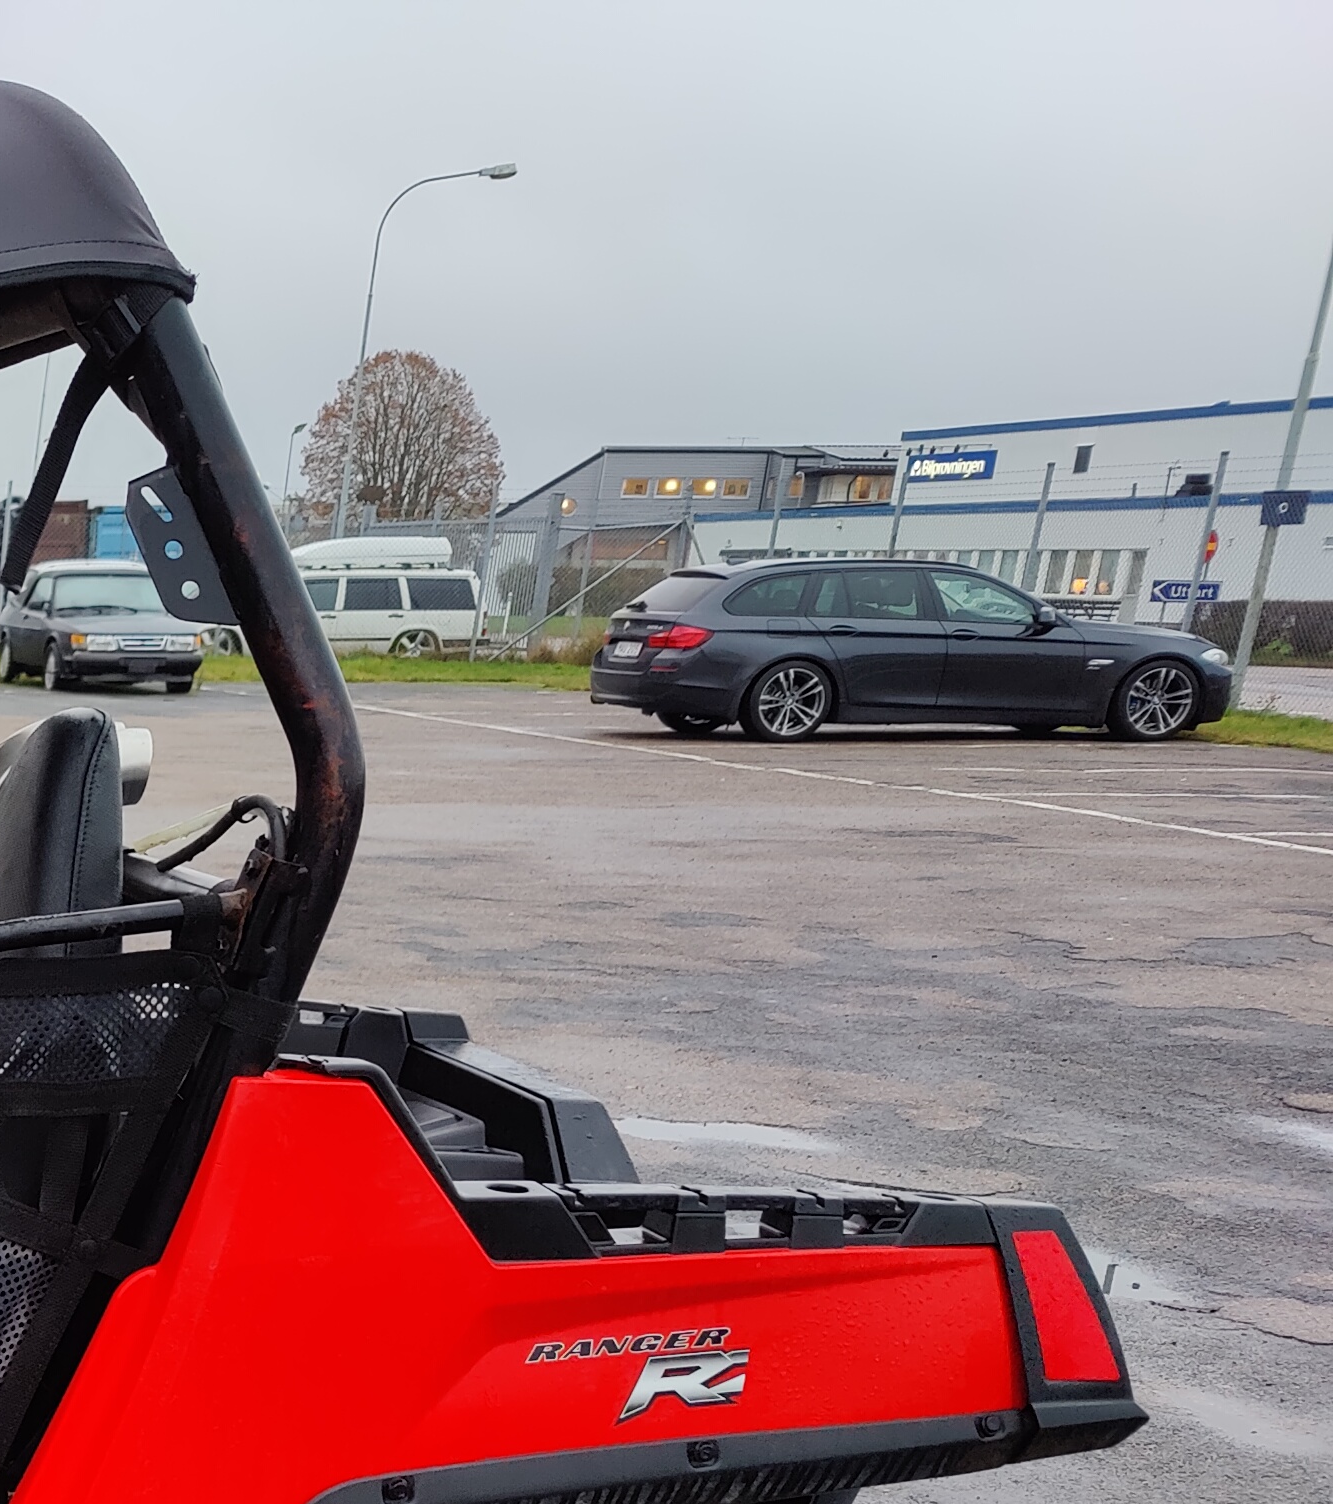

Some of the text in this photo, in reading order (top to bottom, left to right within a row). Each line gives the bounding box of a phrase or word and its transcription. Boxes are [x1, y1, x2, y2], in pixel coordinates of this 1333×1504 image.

[921, 457, 986, 479] Bilprovningen
[1171, 585, 1214, 599] Utrt
[524, 1326, 732, 1364] RANGER
